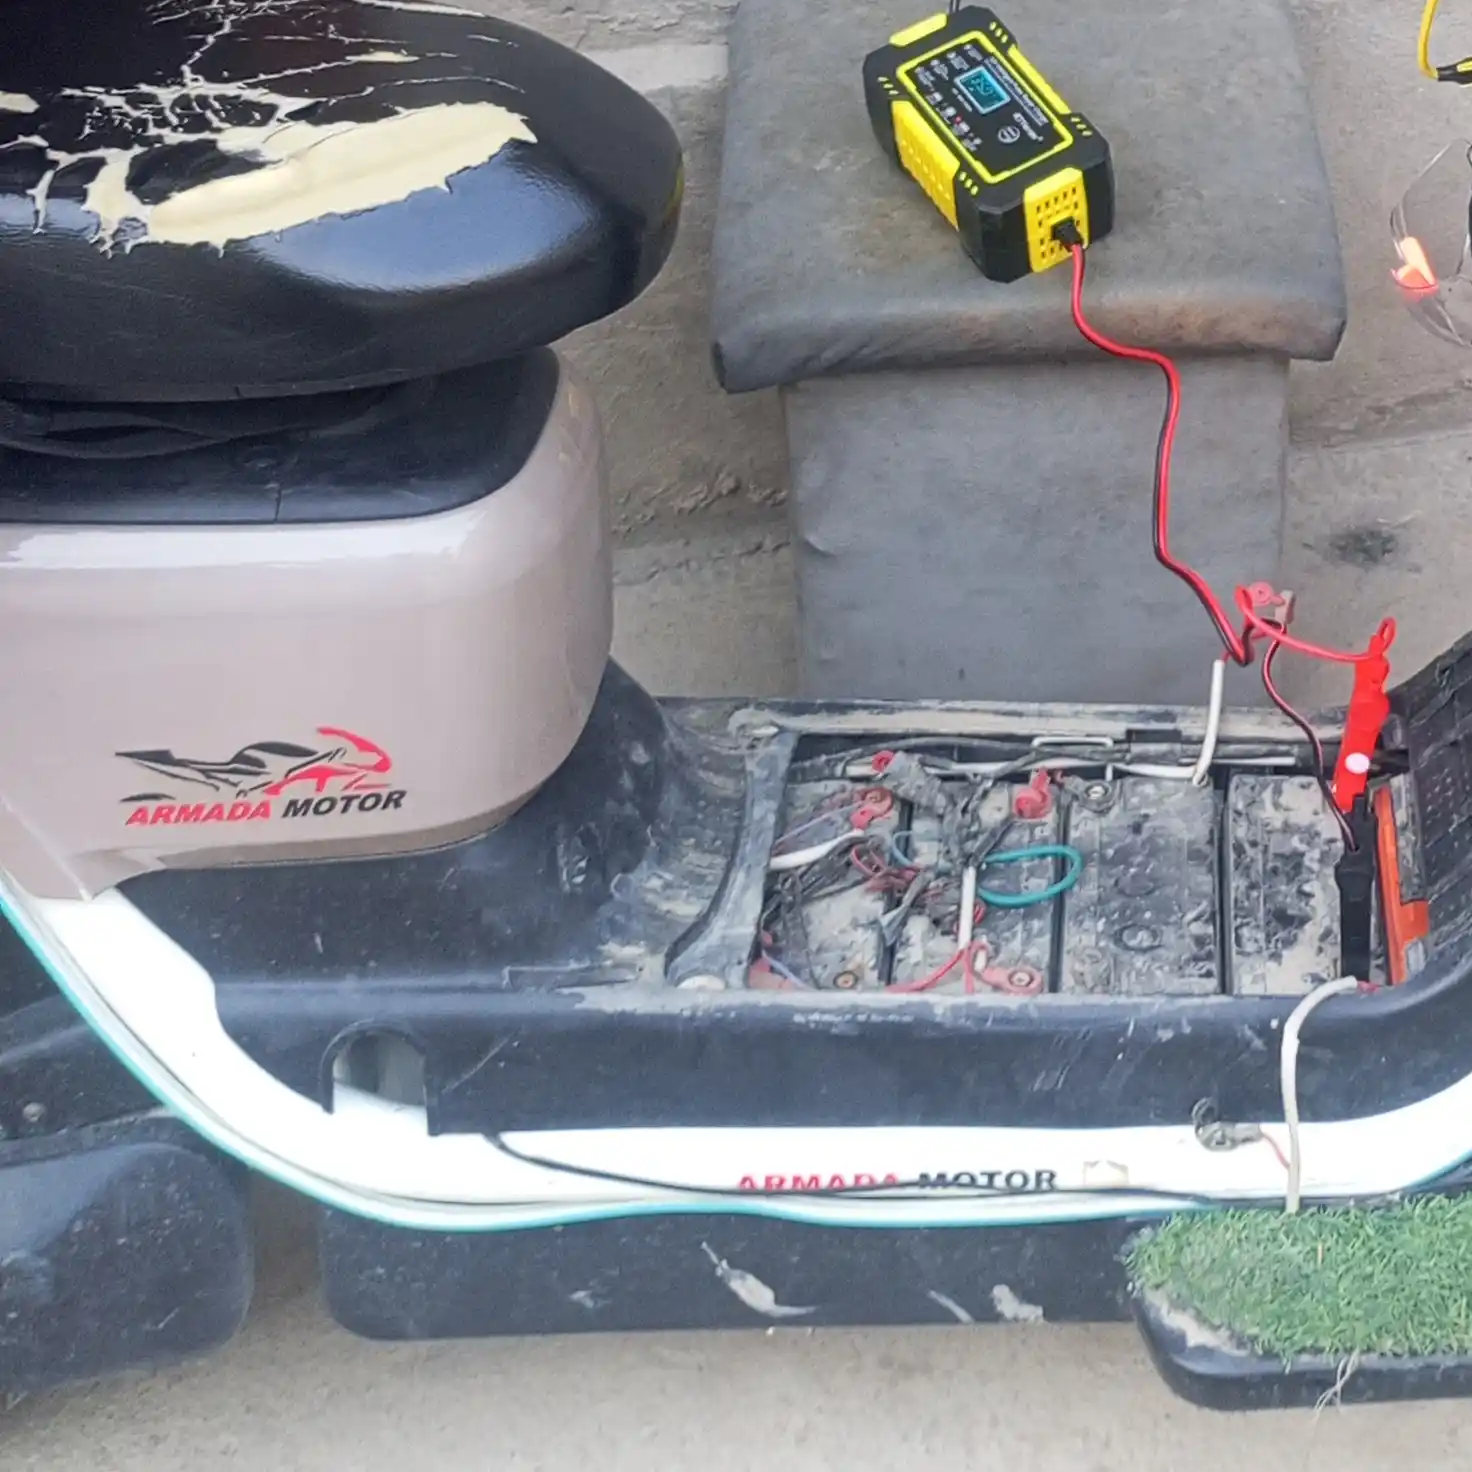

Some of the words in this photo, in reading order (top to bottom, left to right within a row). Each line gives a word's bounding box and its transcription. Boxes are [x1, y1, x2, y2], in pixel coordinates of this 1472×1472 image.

[125, 799, 271, 826] ARMADA
[281, 790, 407, 818] MOTOR
[739, 1173, 898, 1192] ARMADA
[918, 1169, 1058, 1191] MOTOR
